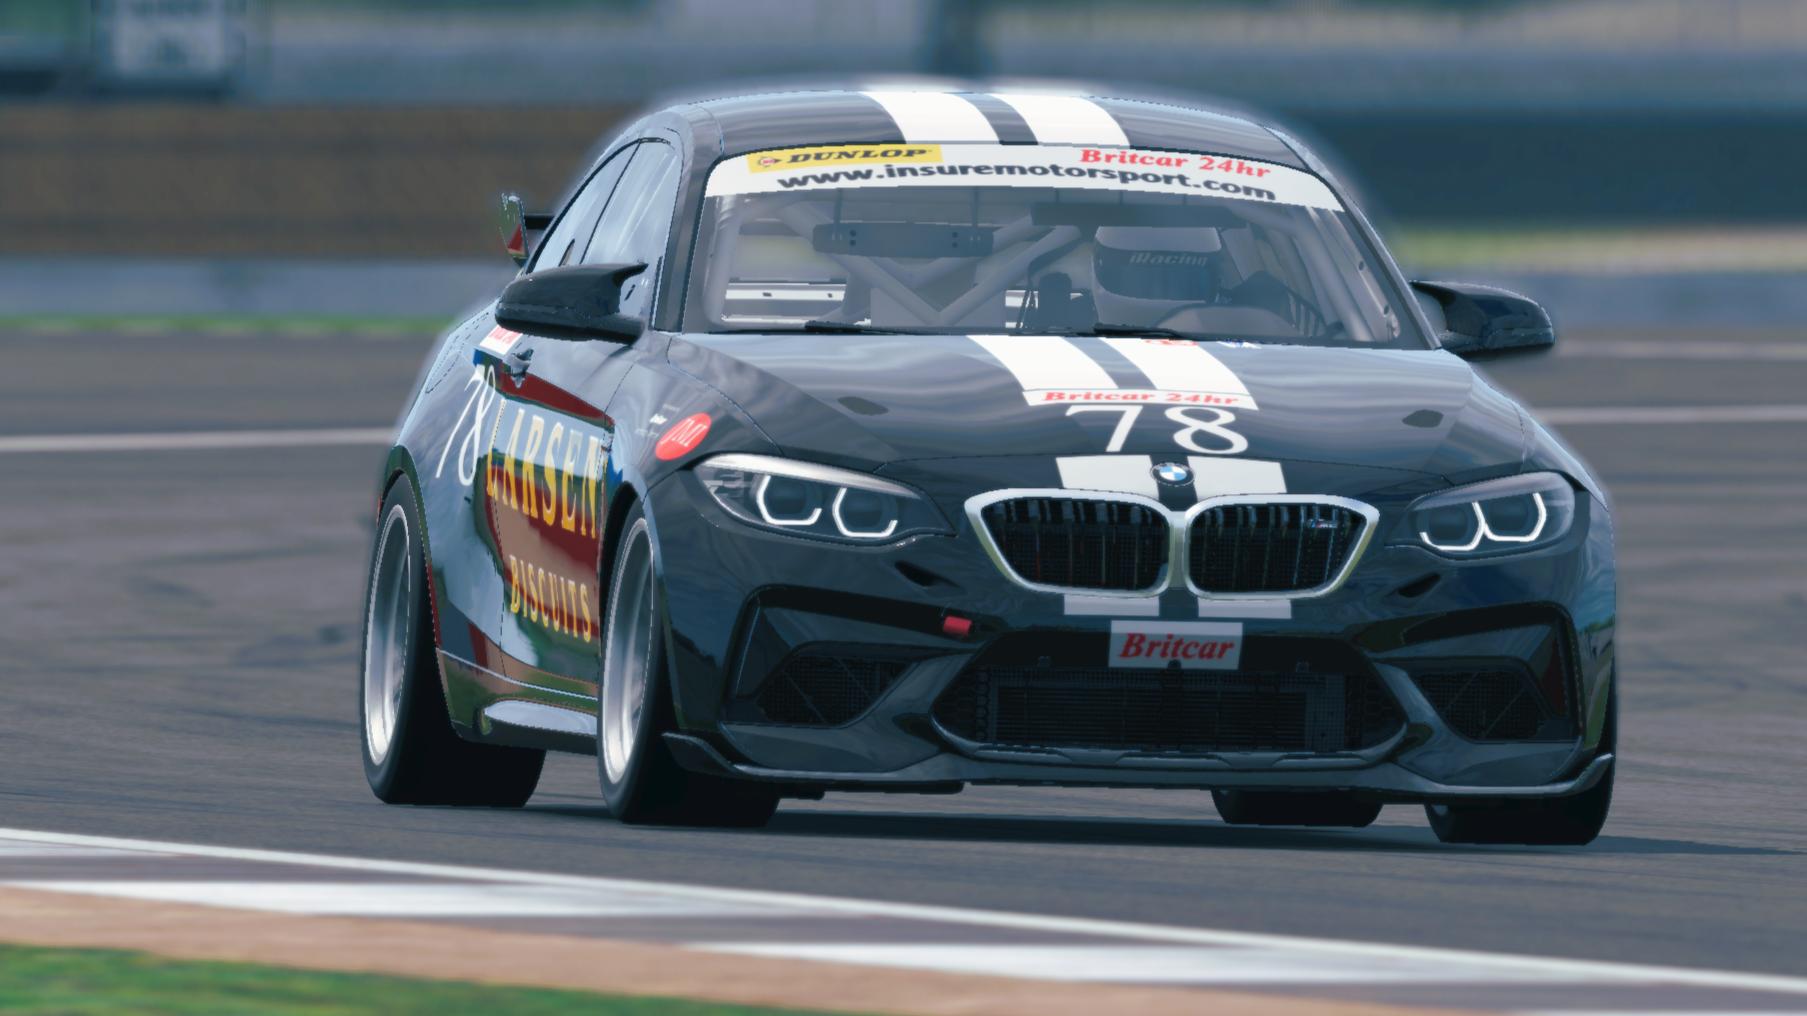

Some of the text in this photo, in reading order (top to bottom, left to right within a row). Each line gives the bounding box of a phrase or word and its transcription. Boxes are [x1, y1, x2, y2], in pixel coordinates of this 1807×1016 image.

[787, 149, 927, 163] DUNLOP
[1079, 149, 1271, 177] Britcar 24hr
[777, 163, 1276, 200] www.insuremotorsport.com
[1044, 391, 1240, 405] Britcar 24hr
[435, 363, 496, 486] 78
[1065, 404, 1249, 454] 78
[486, 397, 608, 540] LARSEN
[508, 554, 591, 643] BISCUITS
[1118, 632, 1235, 660] Britcar
